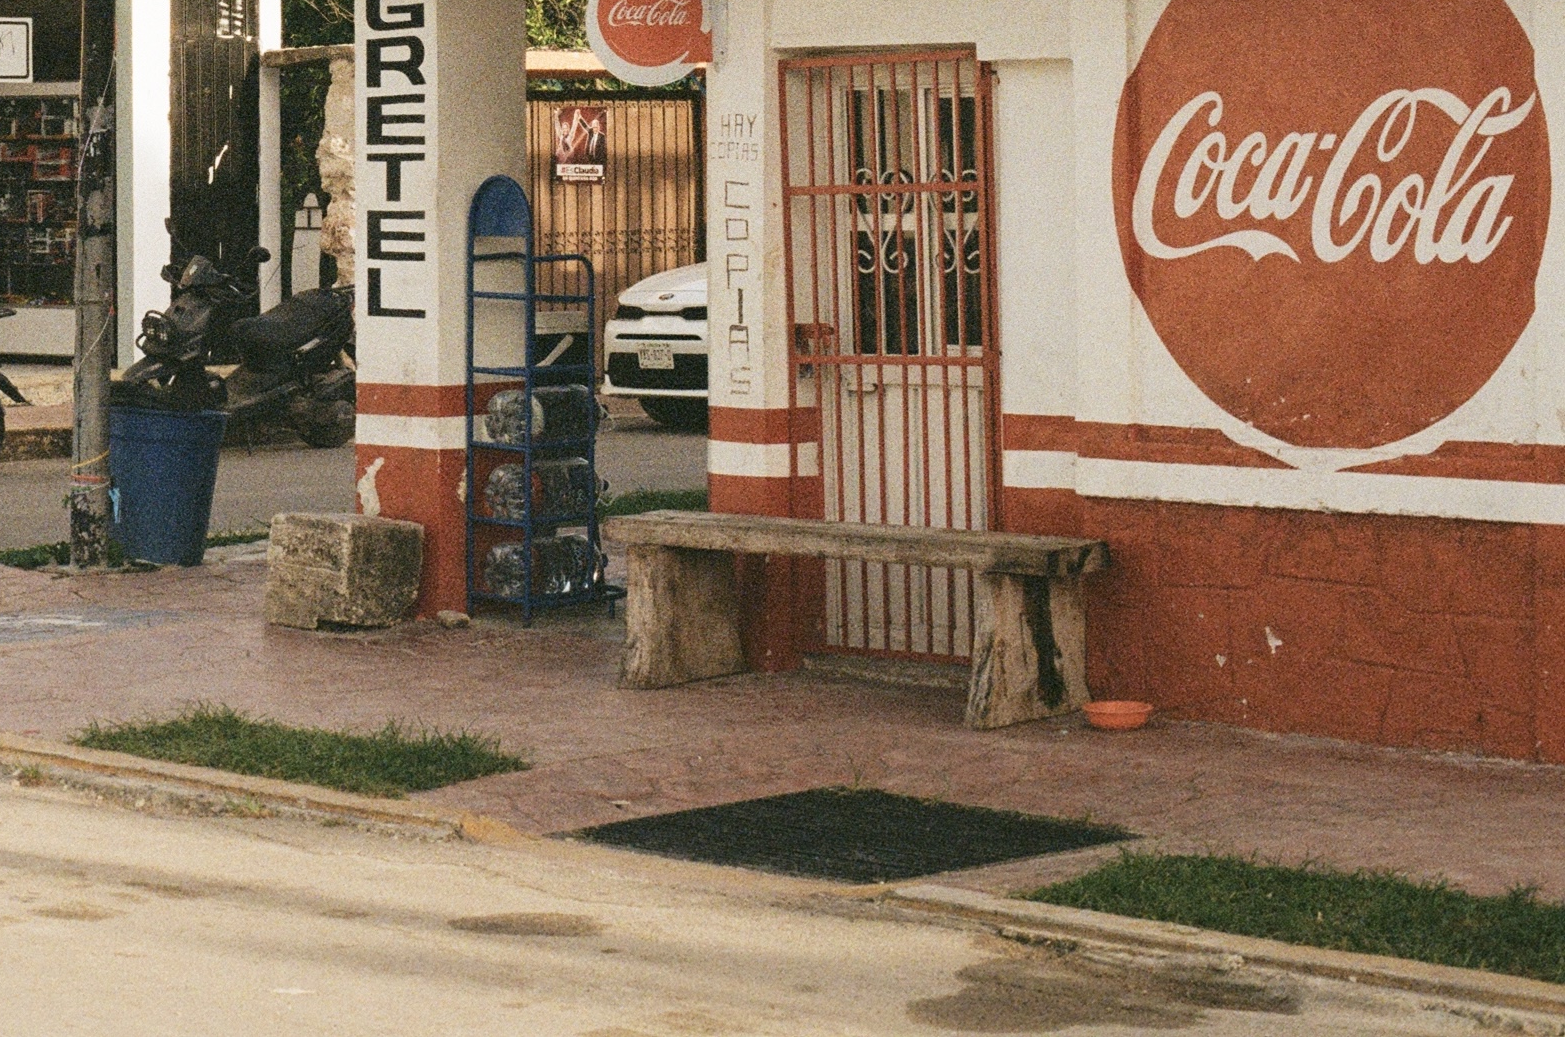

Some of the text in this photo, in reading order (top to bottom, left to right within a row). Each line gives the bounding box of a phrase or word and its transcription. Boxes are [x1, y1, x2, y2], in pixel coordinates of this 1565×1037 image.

[710, 141, 759, 161] COPIAS
[720, 113, 757, 137] HAY
[1132, 86, 1535, 264] Coca-Cola
[724, 180, 751, 395] COPIAS
